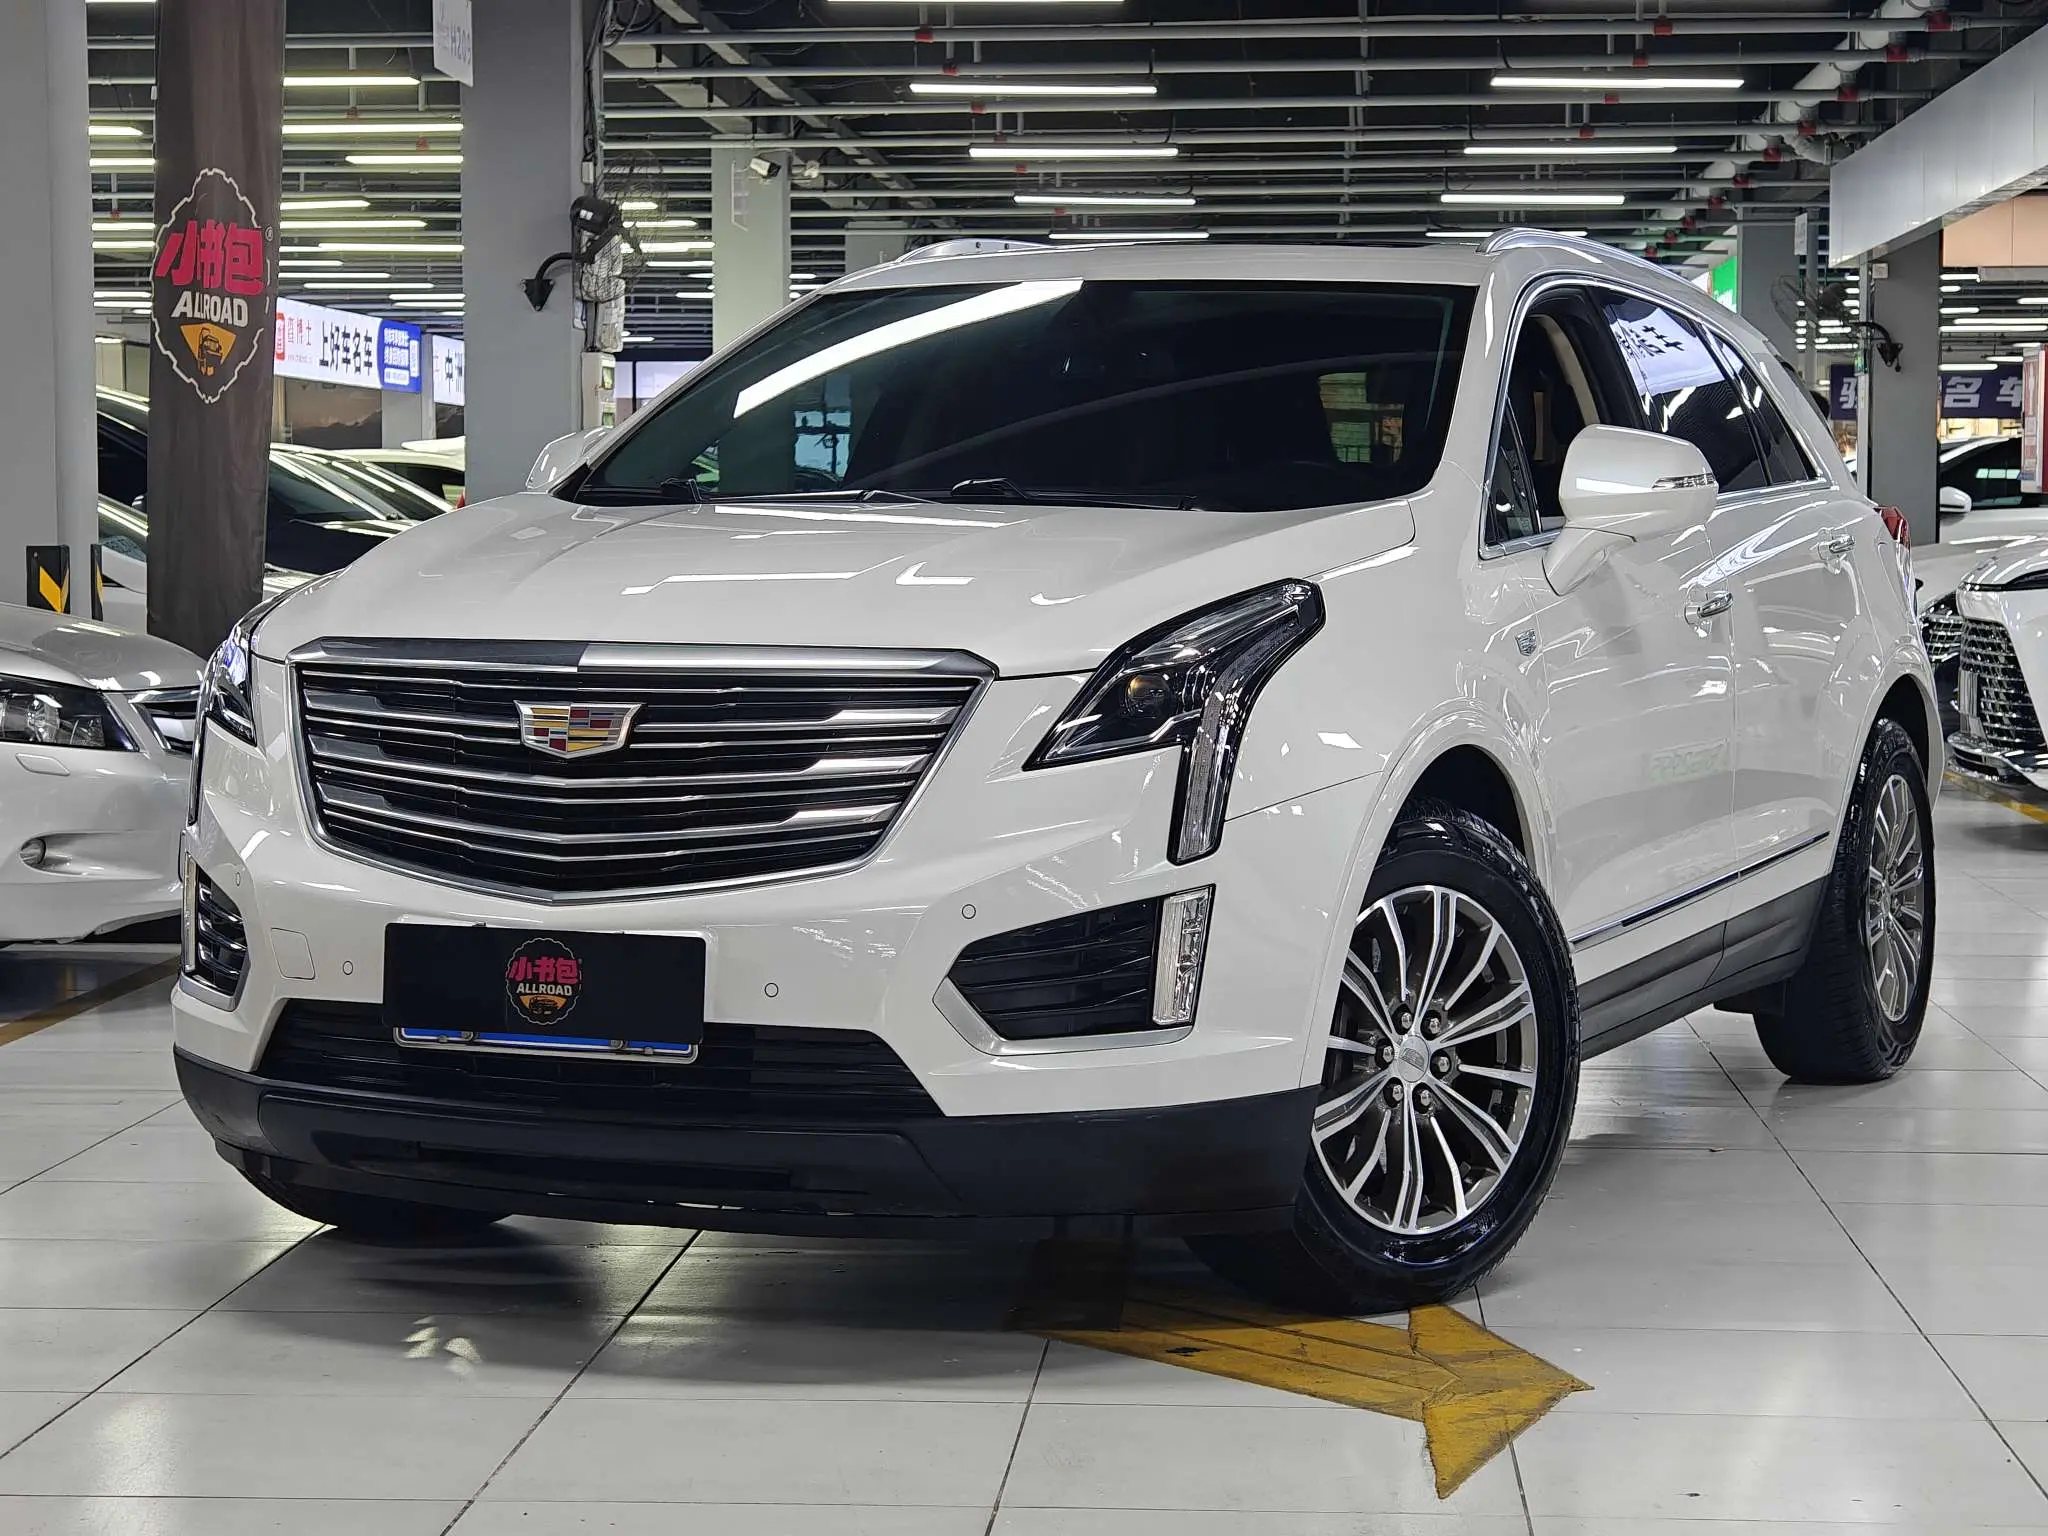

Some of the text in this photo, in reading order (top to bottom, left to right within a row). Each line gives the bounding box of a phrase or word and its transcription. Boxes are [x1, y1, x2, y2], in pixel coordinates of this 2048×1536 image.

[171, 290, 249, 328] ALLROAD
[319, 320, 373, 376] 上好车名车
[508, 956, 579, 985] 小书包
[516, 982, 573, 997] ALLROAD
